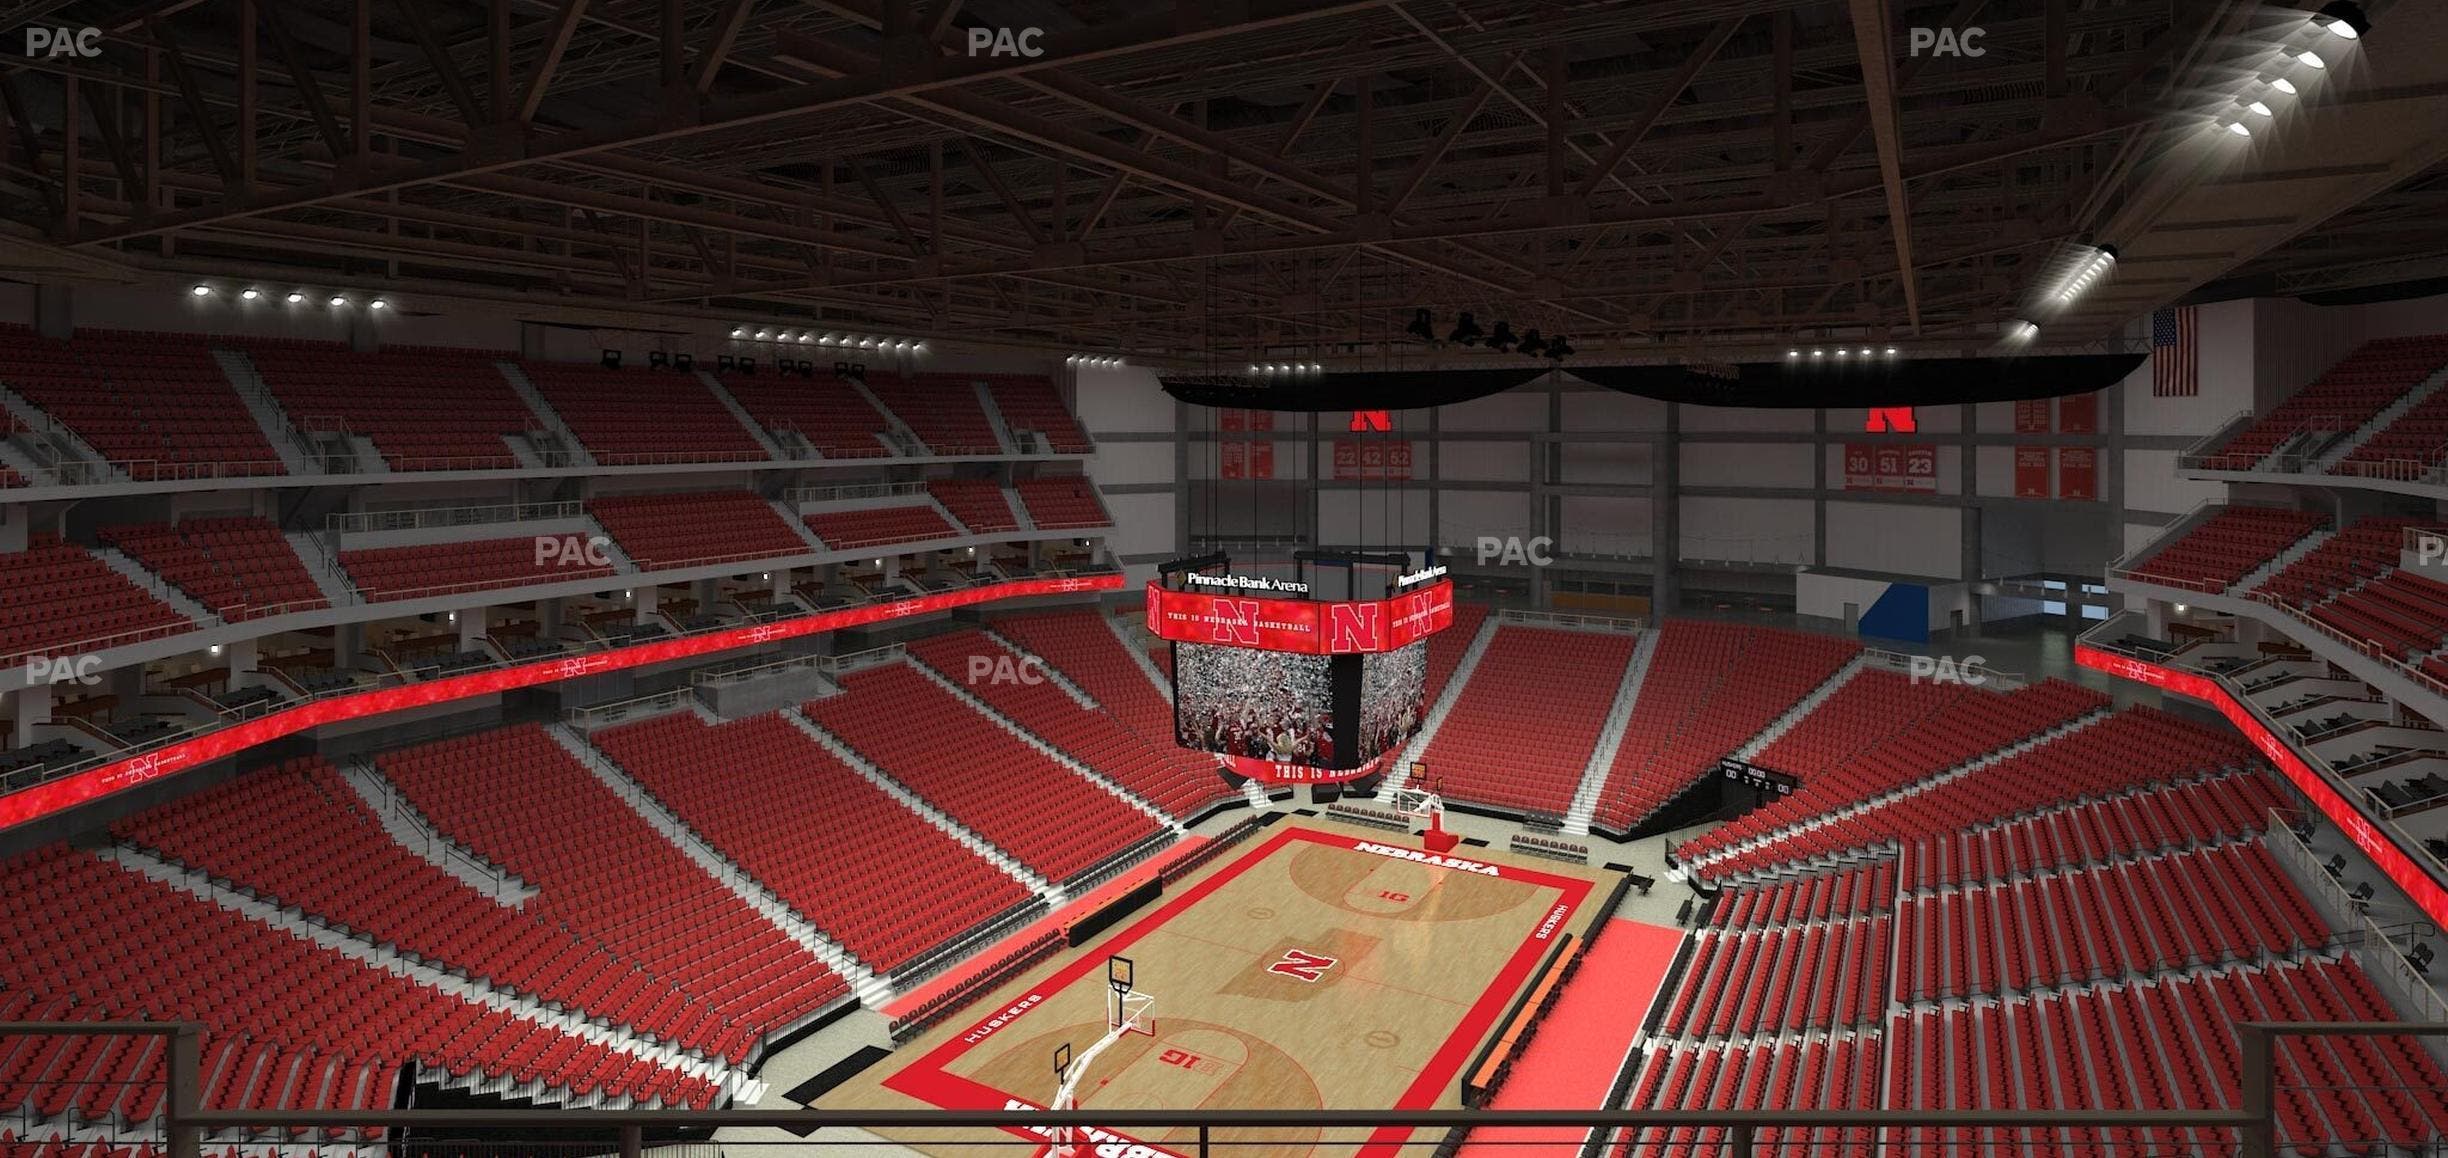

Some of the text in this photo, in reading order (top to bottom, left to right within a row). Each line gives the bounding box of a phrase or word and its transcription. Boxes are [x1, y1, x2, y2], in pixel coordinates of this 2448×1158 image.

[1908, 458, 1932, 474] 23
[1271, 579, 1309, 592] Arena
[1213, 598, 1260, 645] N
[1331, 603, 1377, 653] N
[131, 753, 159, 784] N
[1275, 765, 1303, 779] THIS
[1311, 765, 1323, 779] IS
[1353, 841, 1500, 877] NEBRASKA
[1535, 904, 1569, 940] HUSKERS
[1267, 949, 1338, 983] N
[964, 994, 1042, 1043] HUSKERS
